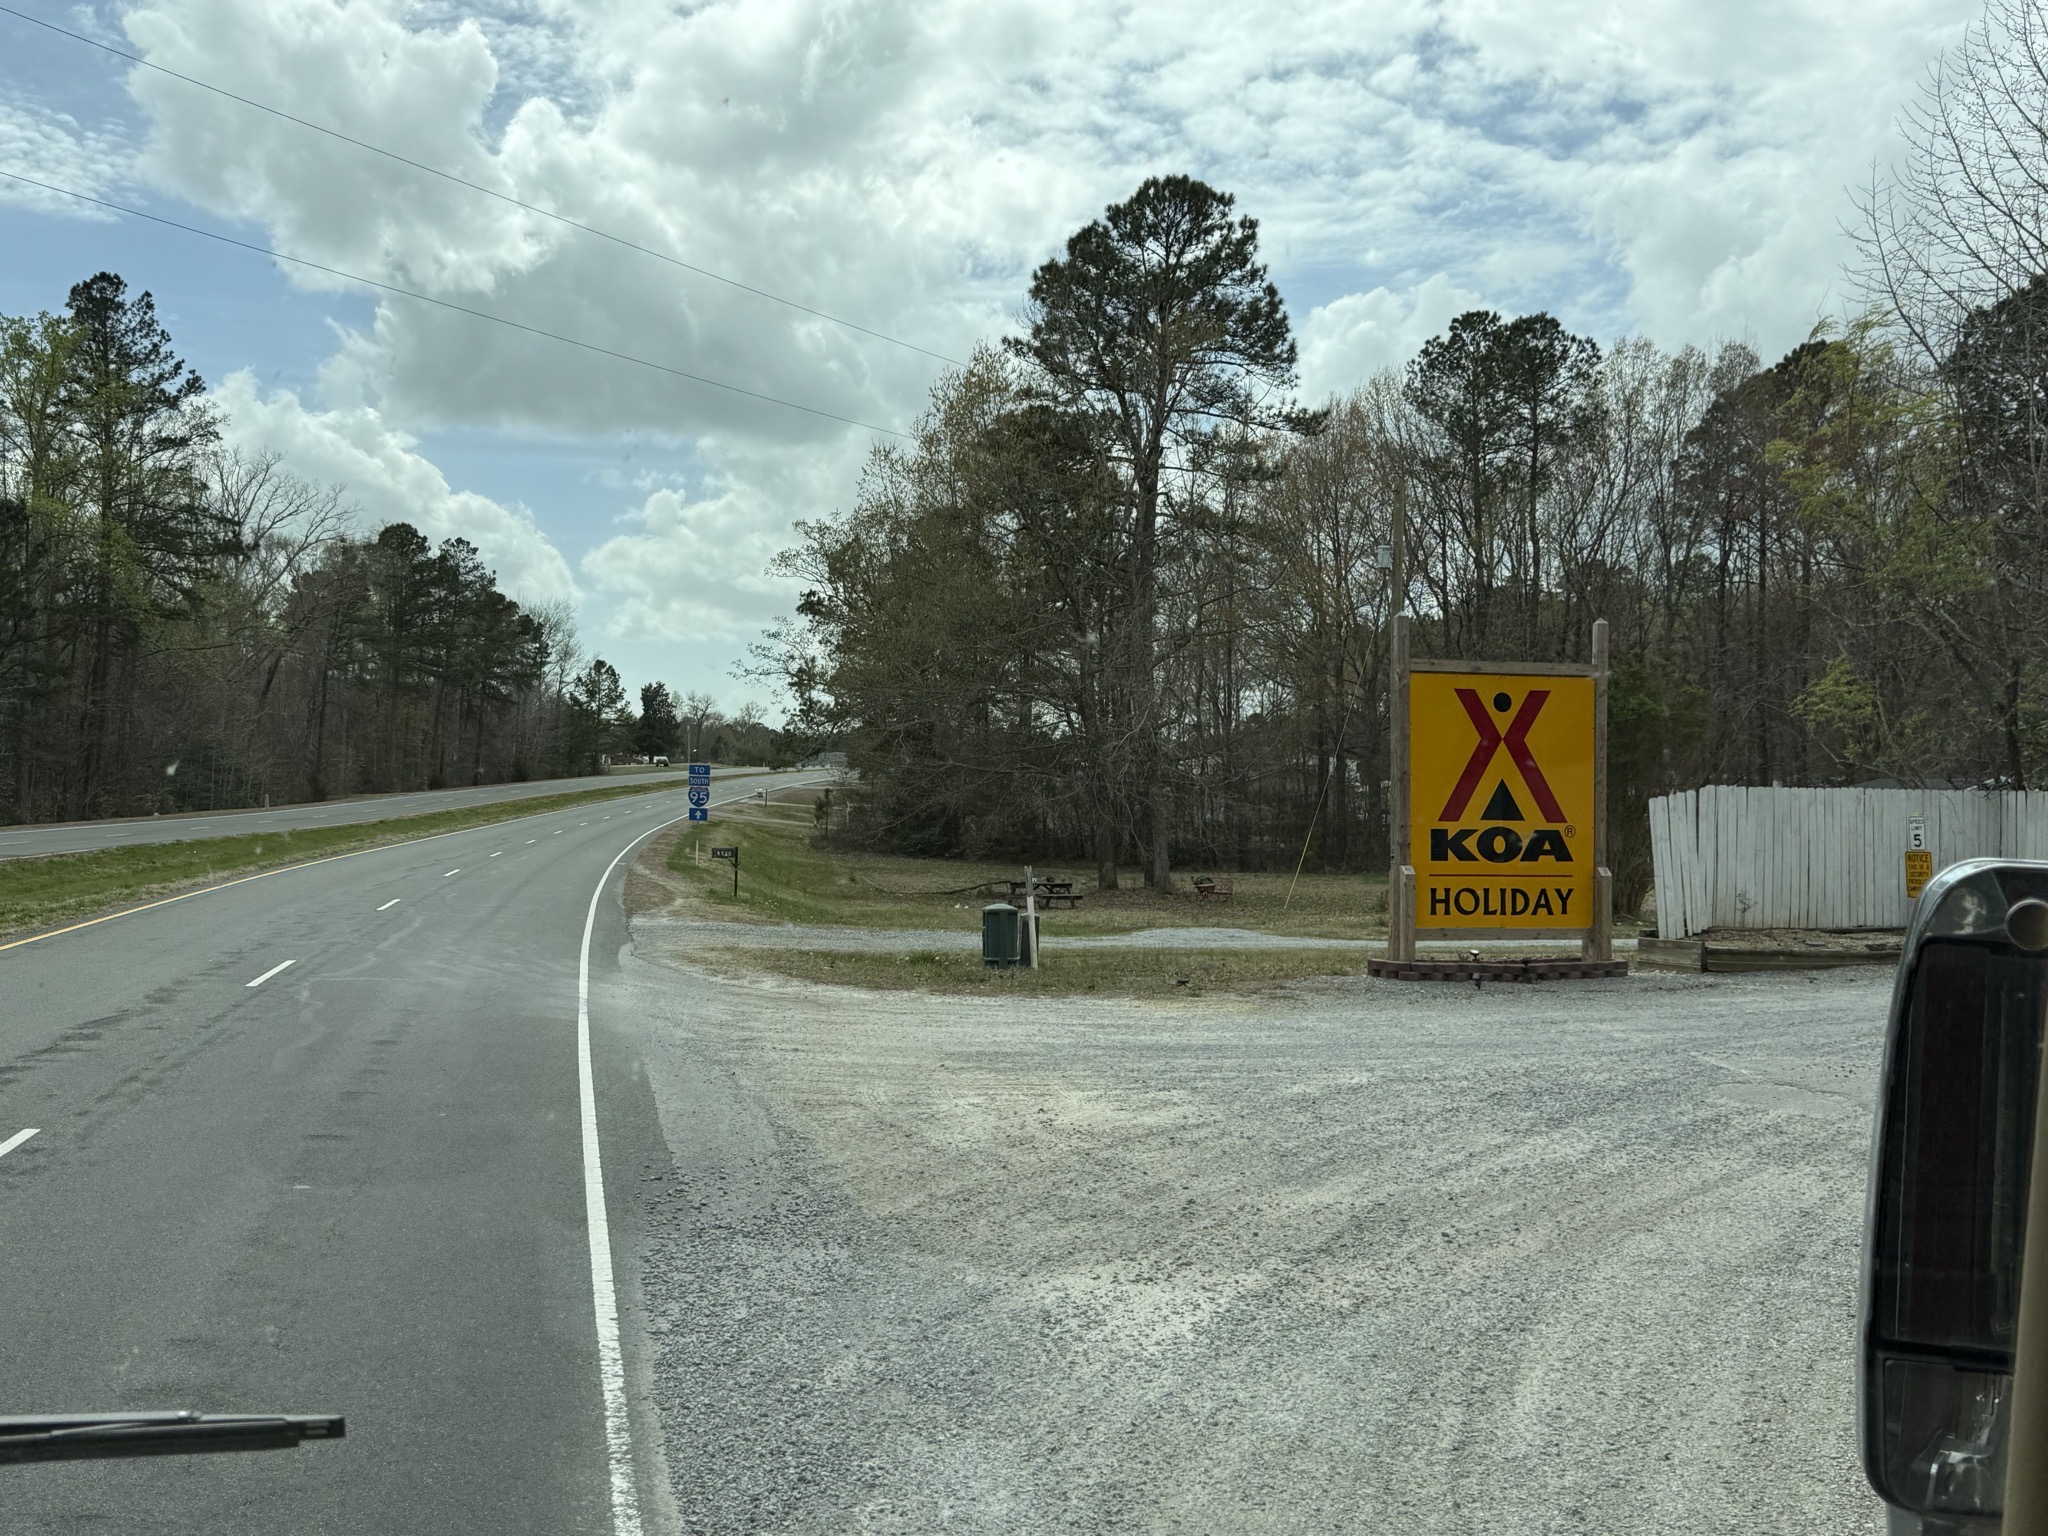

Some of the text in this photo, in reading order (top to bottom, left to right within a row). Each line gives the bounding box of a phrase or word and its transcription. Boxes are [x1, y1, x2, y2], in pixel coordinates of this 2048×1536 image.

[694, 766, 705, 774] TO
[689, 777, 709, 785] SOUTH
[689, 791, 708, 804] 95
[1913, 833, 1922, 848] 5
[1907, 853, 1929, 863] NOTICE
[1429, 887, 1574, 915] HOLIDAY
